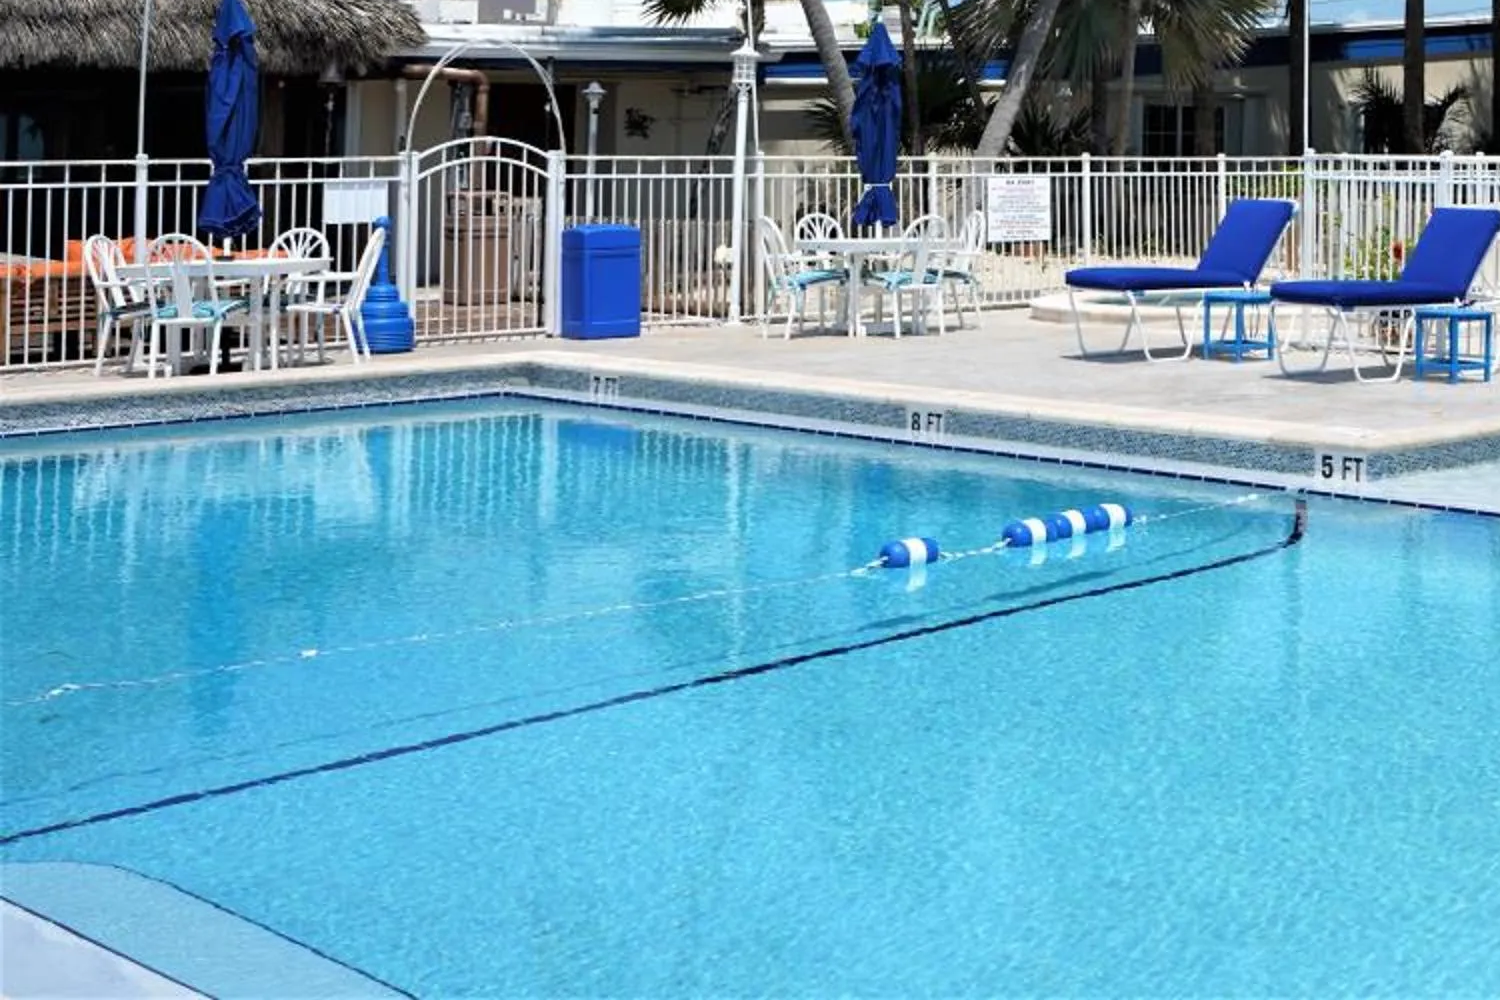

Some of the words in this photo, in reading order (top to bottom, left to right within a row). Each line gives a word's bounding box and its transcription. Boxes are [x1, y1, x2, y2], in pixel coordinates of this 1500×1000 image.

[911, 411, 921, 431] 8
[926, 413, 943, 433] FT
[1321, 454, 1334, 479] 5
[1341, 456, 1364, 482] FT
